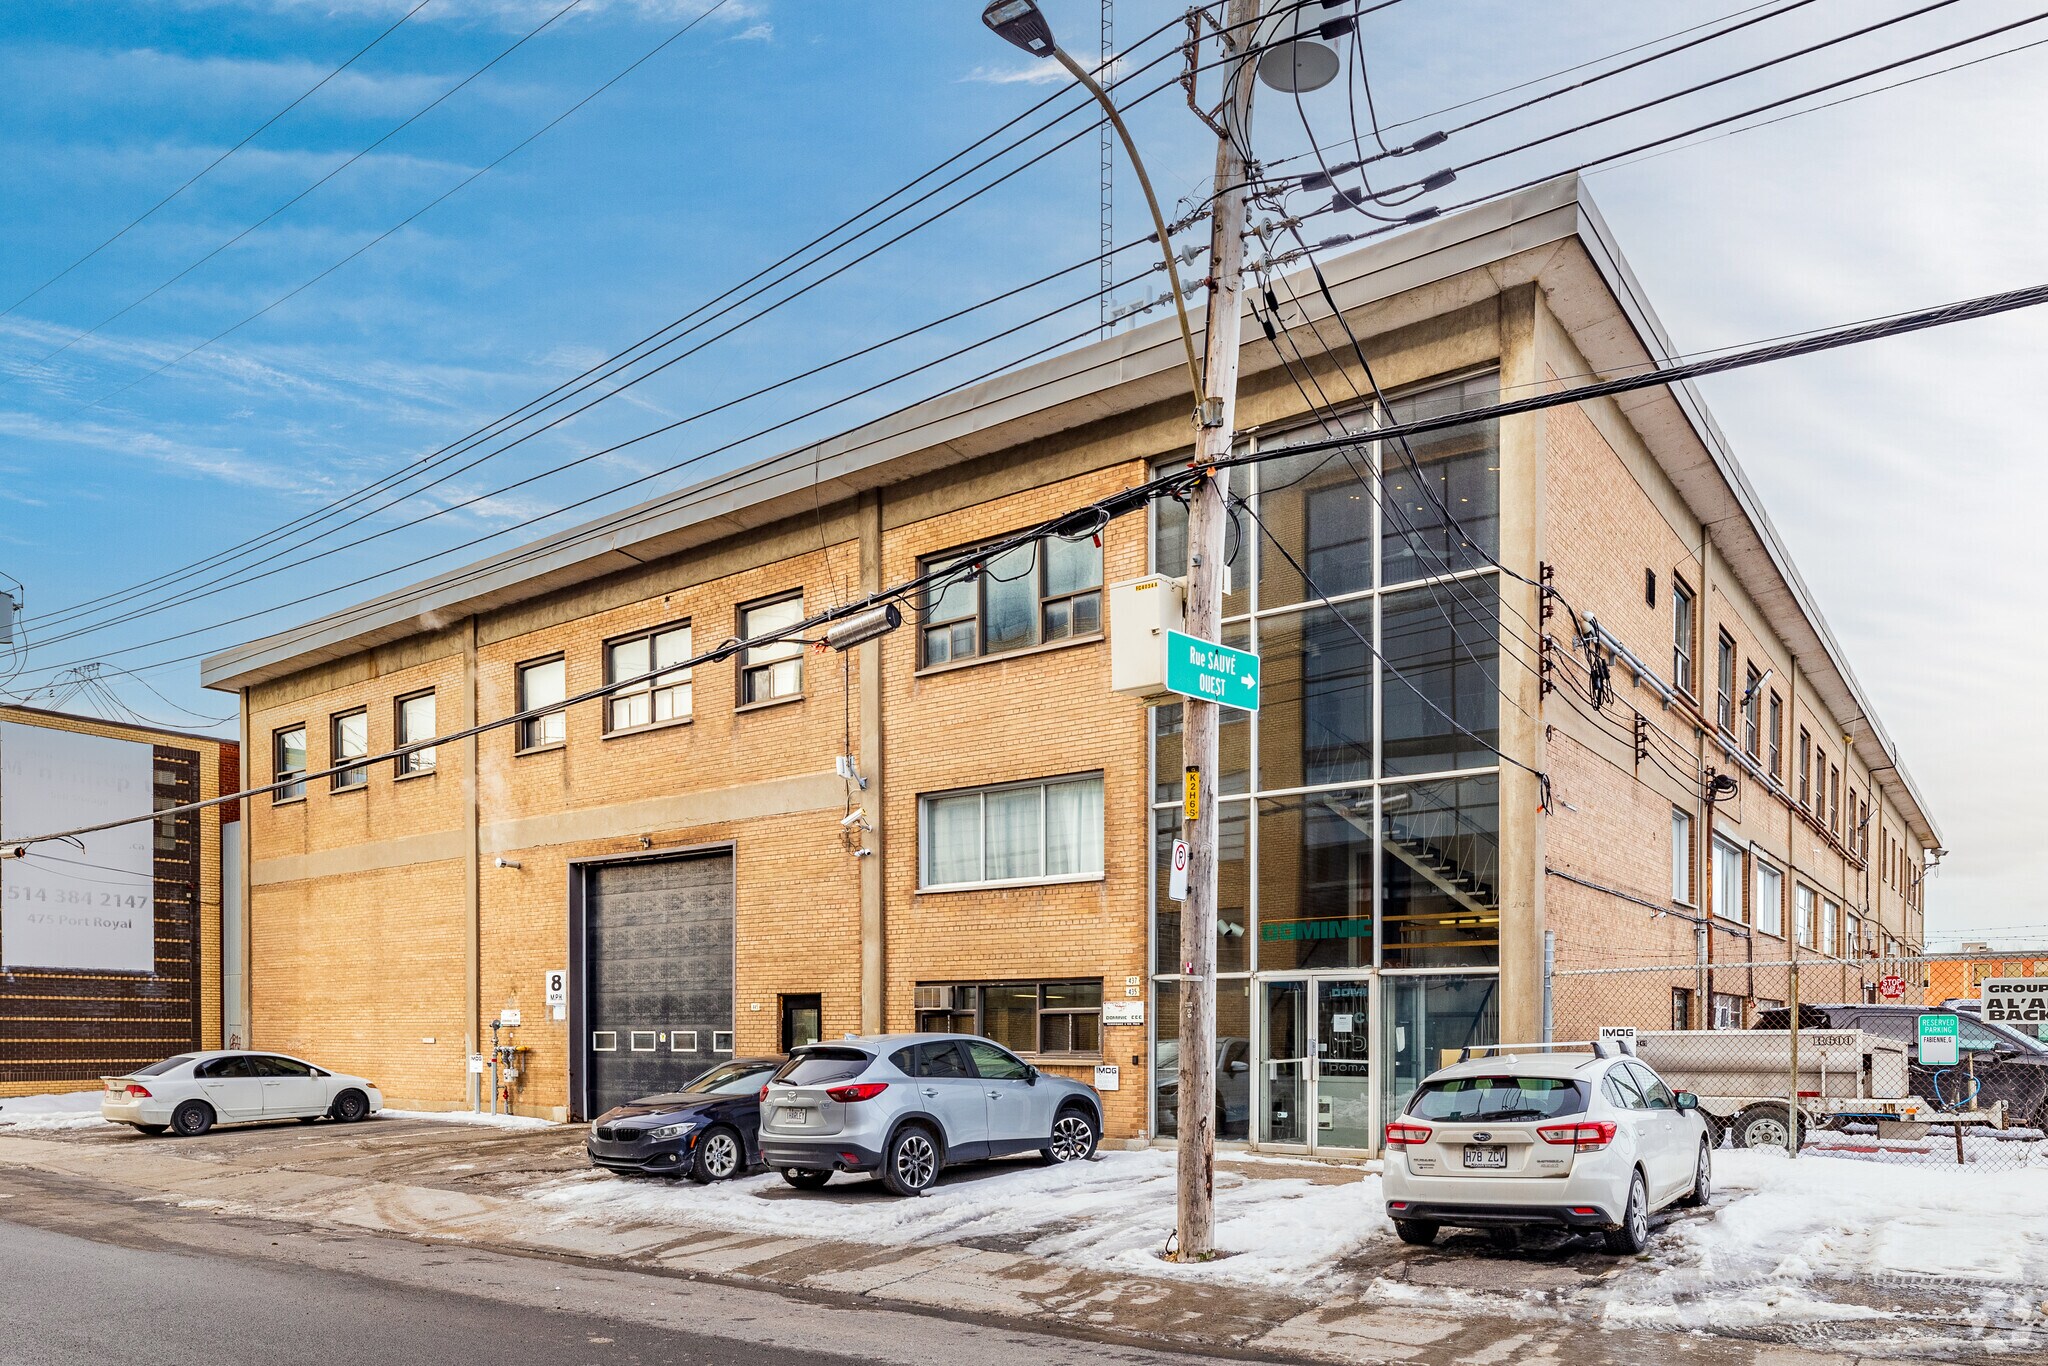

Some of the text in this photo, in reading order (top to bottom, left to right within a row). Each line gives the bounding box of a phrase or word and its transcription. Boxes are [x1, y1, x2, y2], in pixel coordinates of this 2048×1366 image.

[1189, 646, 1236, 675] Rue SAUVÉ
[1199, 673, 1226, 696] OUEST
[7, 886, 148, 909] 514 384 2147
[27, 912, 132, 931] 475 Port Royal
[1262, 919, 1373, 941] DOMINIC
[551, 974, 562, 991] 8
[1882, 978, 1902, 987] STOP
[2007, 998, 2048, 1009] L'A
[1922, 1019, 1955, 1027] RESERVED
[1924, 1026, 1953, 1034] PARKING
[1602, 1028, 1634, 1037] IMOG
[1465, 1151, 1505, 1163] H78 ZCV
